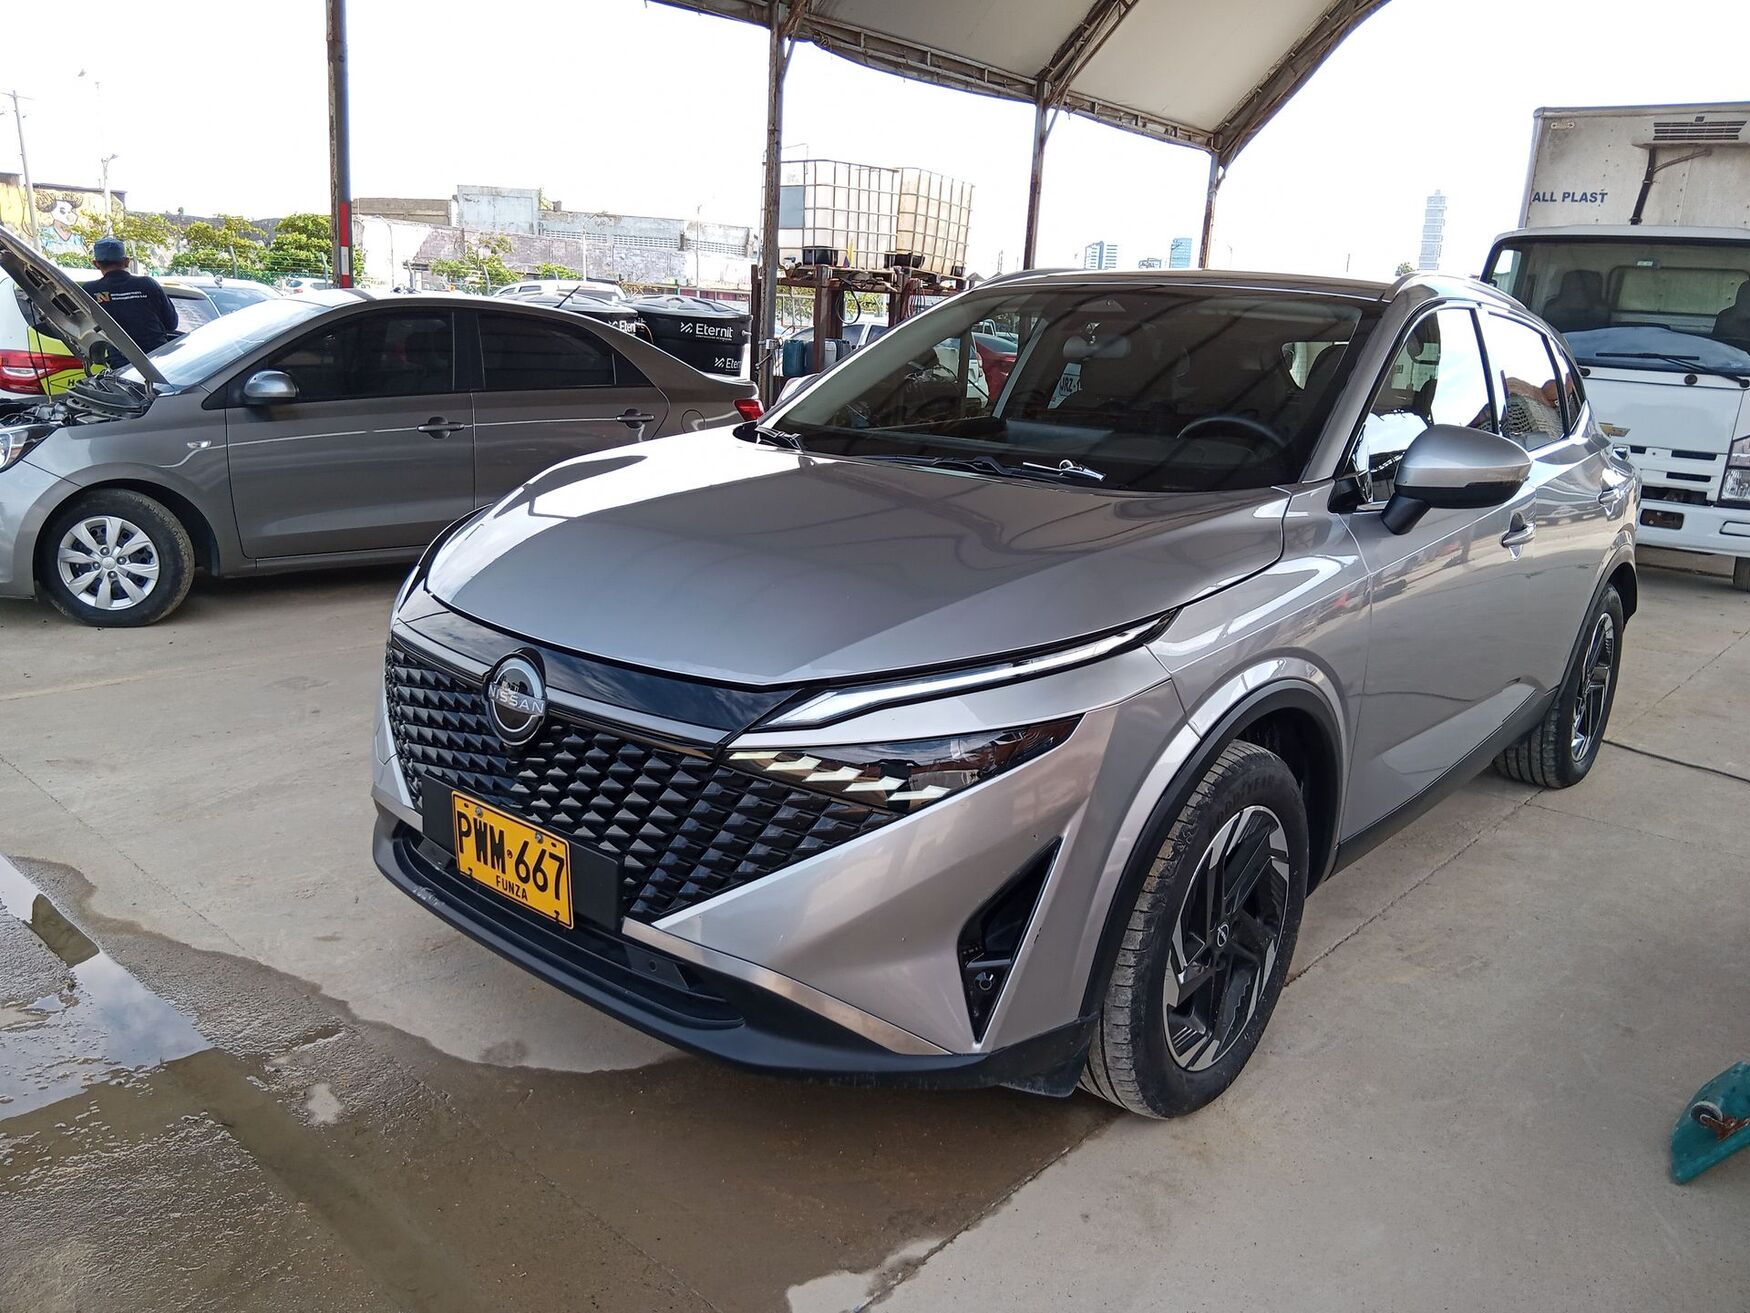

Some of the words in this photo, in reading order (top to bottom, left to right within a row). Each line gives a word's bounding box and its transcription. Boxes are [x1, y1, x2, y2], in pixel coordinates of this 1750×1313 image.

[1532, 192, 1557, 203] ALL
[1562, 192, 1608, 203] PLAST
[695, 323, 734, 338] Eternit
[488, 684, 544, 714] NISSAN
[496, 874, 528, 902] FUNZA
